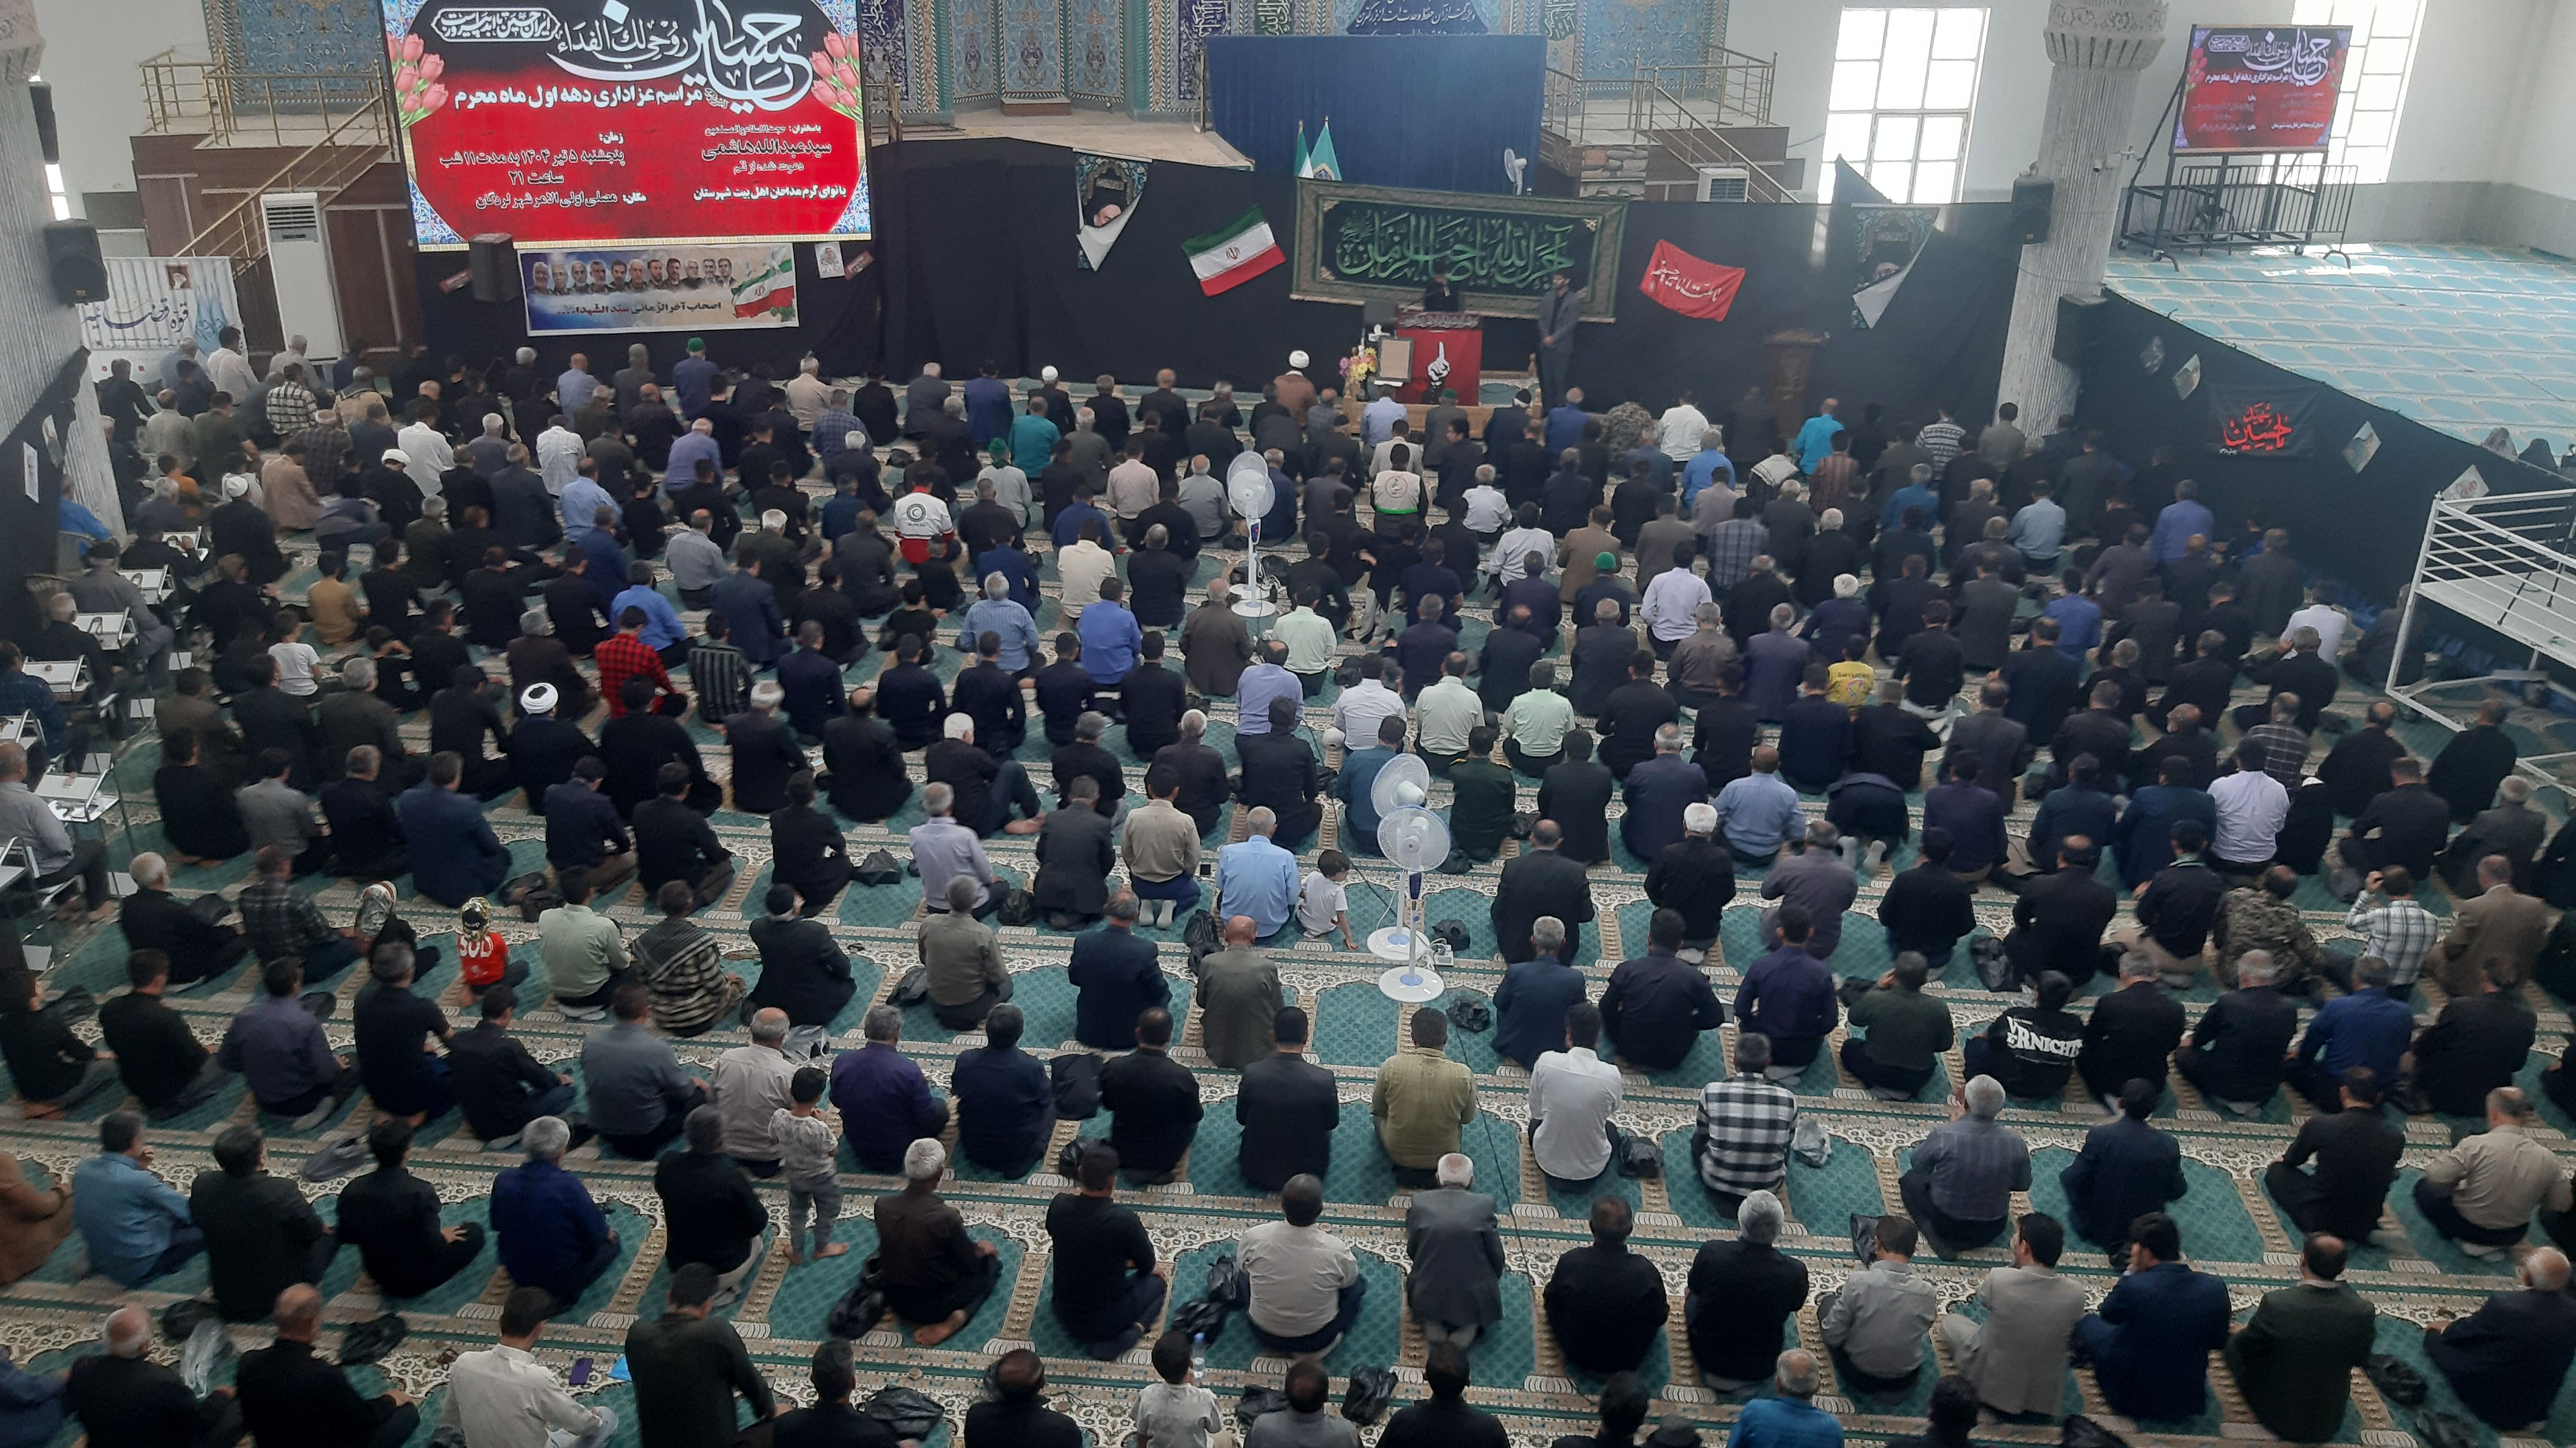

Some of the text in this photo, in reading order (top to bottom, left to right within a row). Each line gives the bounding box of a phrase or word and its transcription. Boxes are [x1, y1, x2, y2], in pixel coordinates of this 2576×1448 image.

[454, 90, 498, 110] محرم
[499, 85, 526, 104] ماه
[527, 84, 558, 109] اول
[560, 86, 592, 104] دهه
[657, 84, 703, 107] مراسم
[598, 131, 625, 145] زمان:
[552, 149, 569, 167] تیر
[570, 150, 578, 163] ۵
[580, 149, 626, 167] پنجشنبه
[702, 138, 755, 161] هاشمی
[439, 151, 463, 169] شب
[464, 151, 476, 166] ۱۱
[477, 152, 506, 165] مدت
[507, 151, 521, 167] به
[733, 160, 805, 175] دعوت شده از قم
[508, 170, 565, 186] ساعت ۲۱
[512, 191, 533, 210] شهر
[584, 190, 618, 208] مصلی
[693, 185, 732, 201] شهرستان
[733, 188, 751, 200] بیت
[750, 186, 770, 200] اهل
[687, 302, 721, 311] اصحاب
